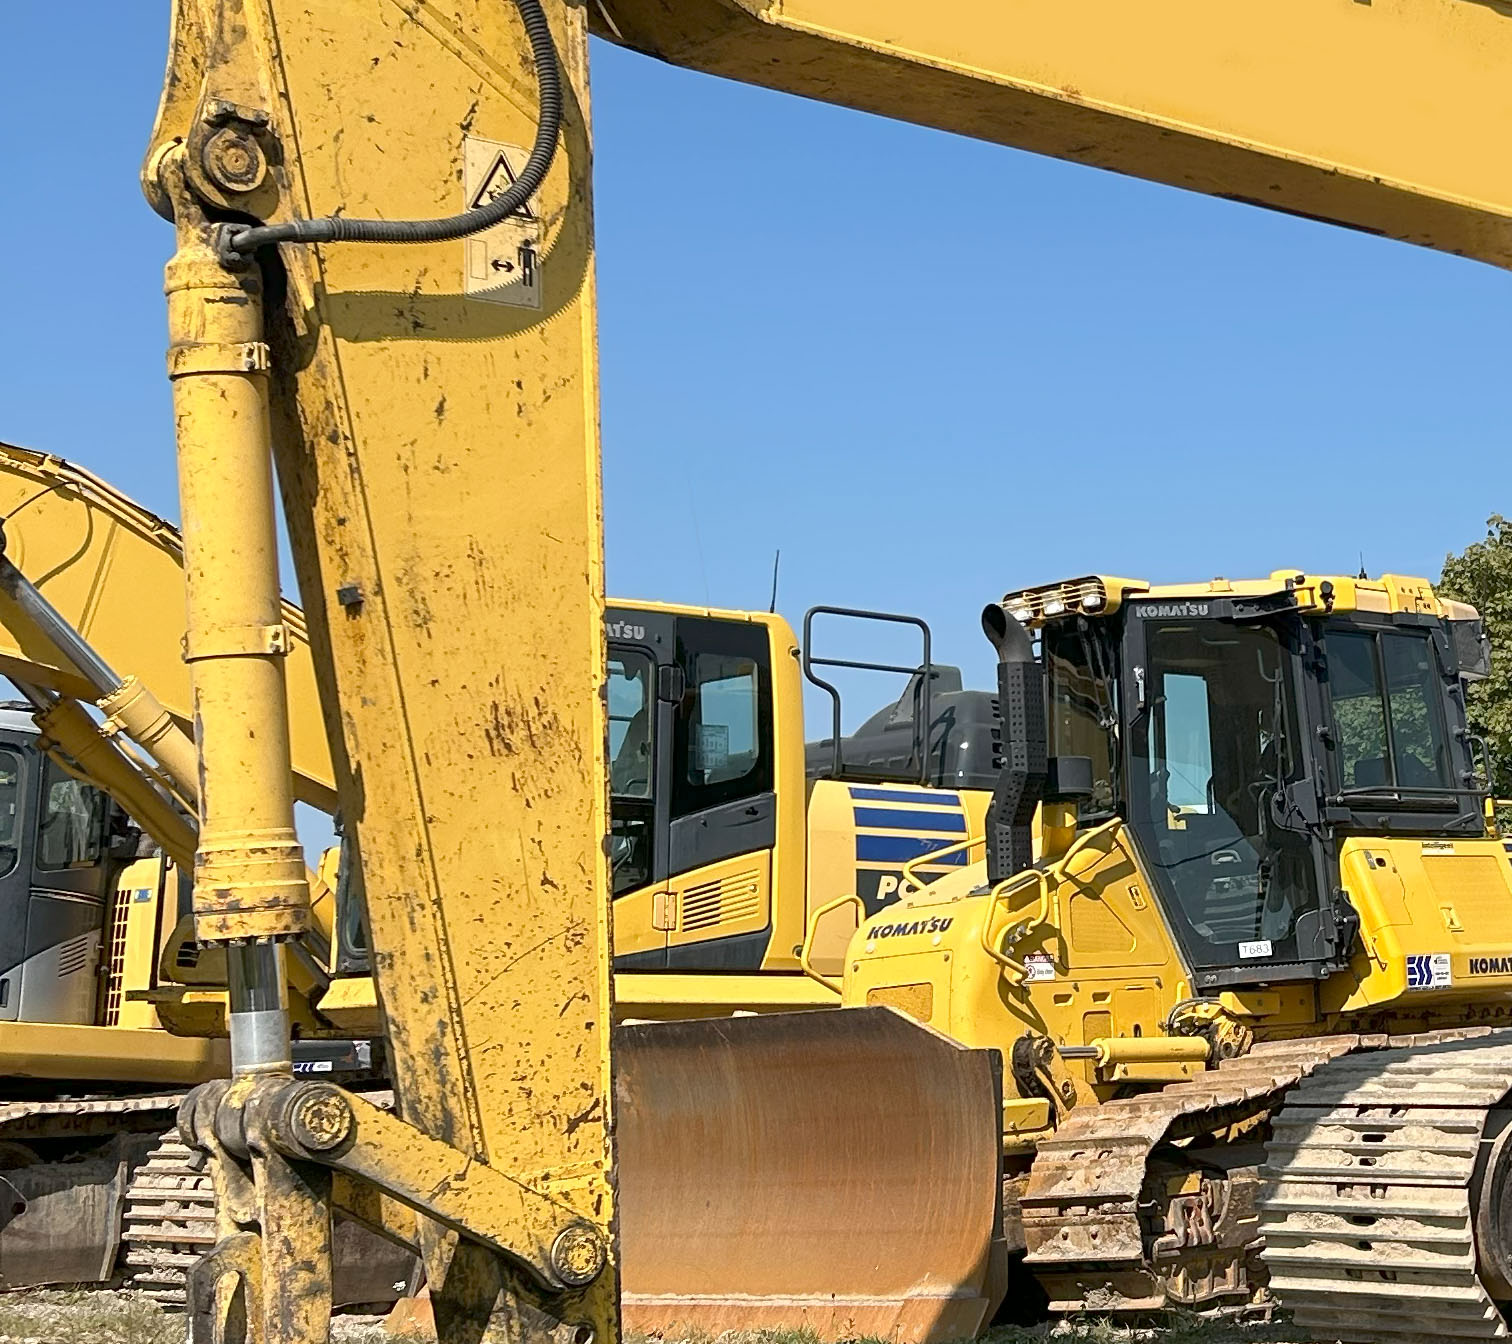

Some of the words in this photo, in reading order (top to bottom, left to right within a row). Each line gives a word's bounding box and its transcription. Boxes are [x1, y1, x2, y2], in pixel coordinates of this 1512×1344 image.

[1135, 601, 1209, 618] KOMATSU
[866, 916, 954, 941] KOMATSU
[1241, 943, 1270, 955] T683
